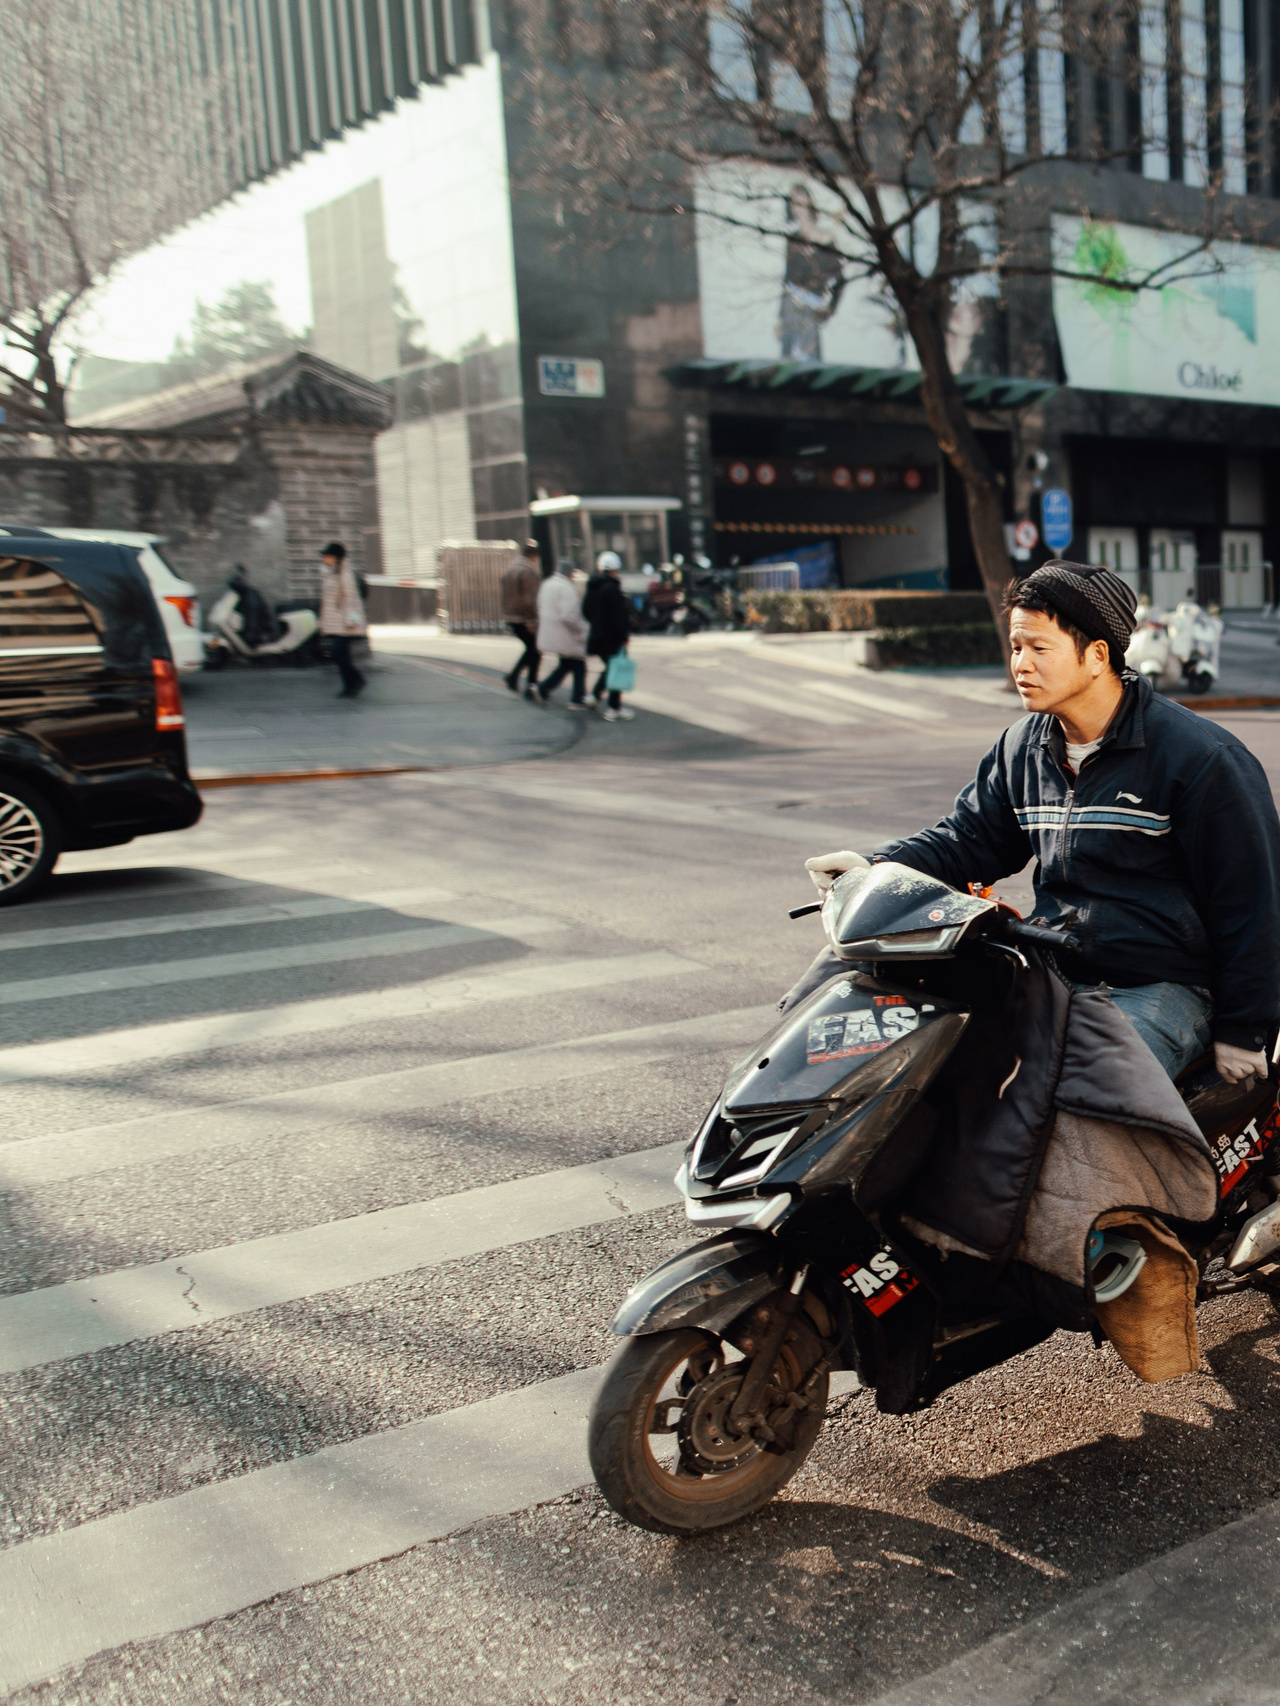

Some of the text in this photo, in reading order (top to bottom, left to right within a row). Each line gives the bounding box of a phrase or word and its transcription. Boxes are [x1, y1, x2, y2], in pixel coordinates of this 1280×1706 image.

[1177, 361, 1243, 392] Chloé
[873, 995, 907, 1006] THE
[808, 1004, 935, 1053] FAS
[842, 1244, 900, 1298] AS
